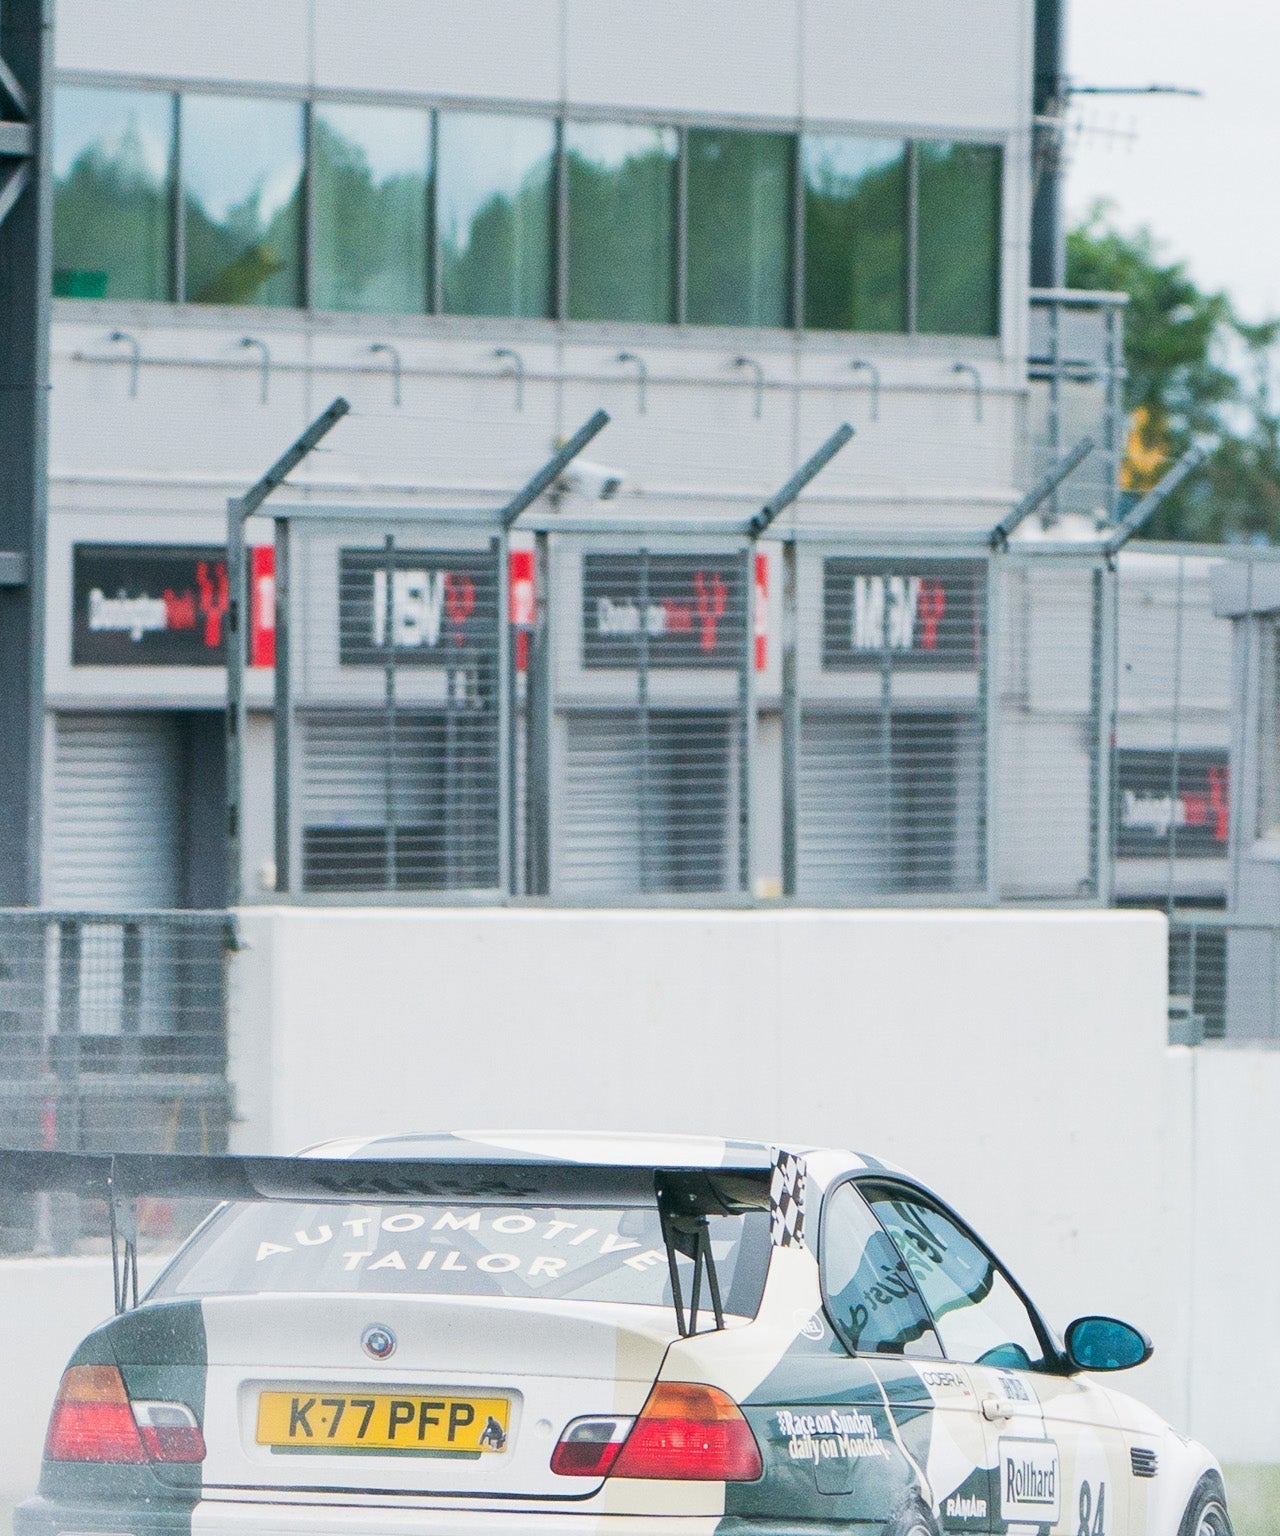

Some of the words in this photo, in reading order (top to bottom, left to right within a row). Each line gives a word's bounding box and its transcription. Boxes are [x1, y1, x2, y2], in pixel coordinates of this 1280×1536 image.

[256, 1211, 668, 1274] AUTOMOTIVE
[342, 1249, 567, 1278] TAILOR
[288, 1397, 376, 1439] K77
[387, 1400, 476, 1443] PFP
[783, 1410, 817, 1436] Race
[815, 1414, 834, 1434] on
[788, 1433, 820, 1466] daily
[820, 1438, 839, 1459] on
